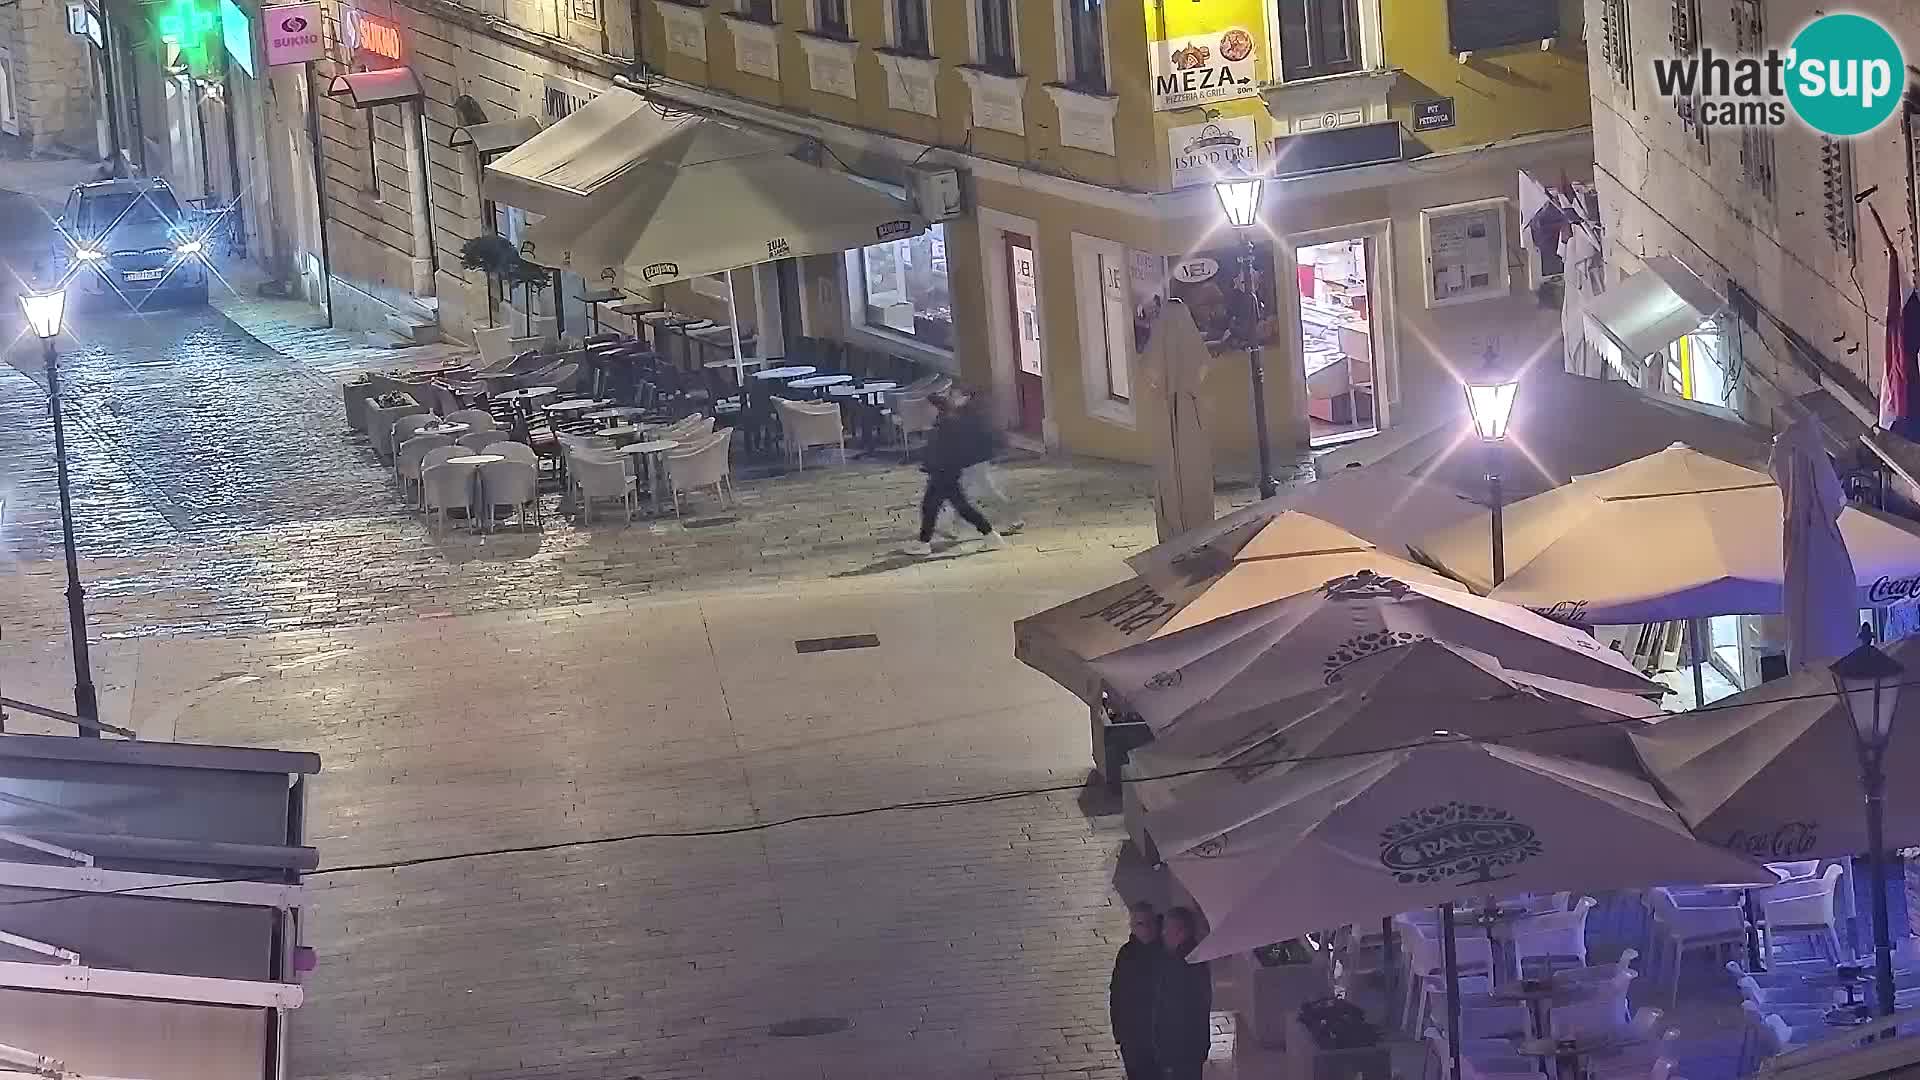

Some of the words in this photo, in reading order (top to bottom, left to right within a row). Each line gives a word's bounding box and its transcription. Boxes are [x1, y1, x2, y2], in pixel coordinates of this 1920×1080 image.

[273, 34, 319, 49] SUKNO
[360, 17, 400, 60] SUKNO
[1156, 65, 1236, 96] MEZA
[1164, 92, 1199, 105] PIZZERIA
[1205, 87, 1228, 99] GRILL
[1427, 105, 1440, 114] PUT
[1418, 114, 1450, 126] PETROVCA
[1174, 151, 1221, 170] ISPOD
[1420, 826, 1518, 858] RAUCH
